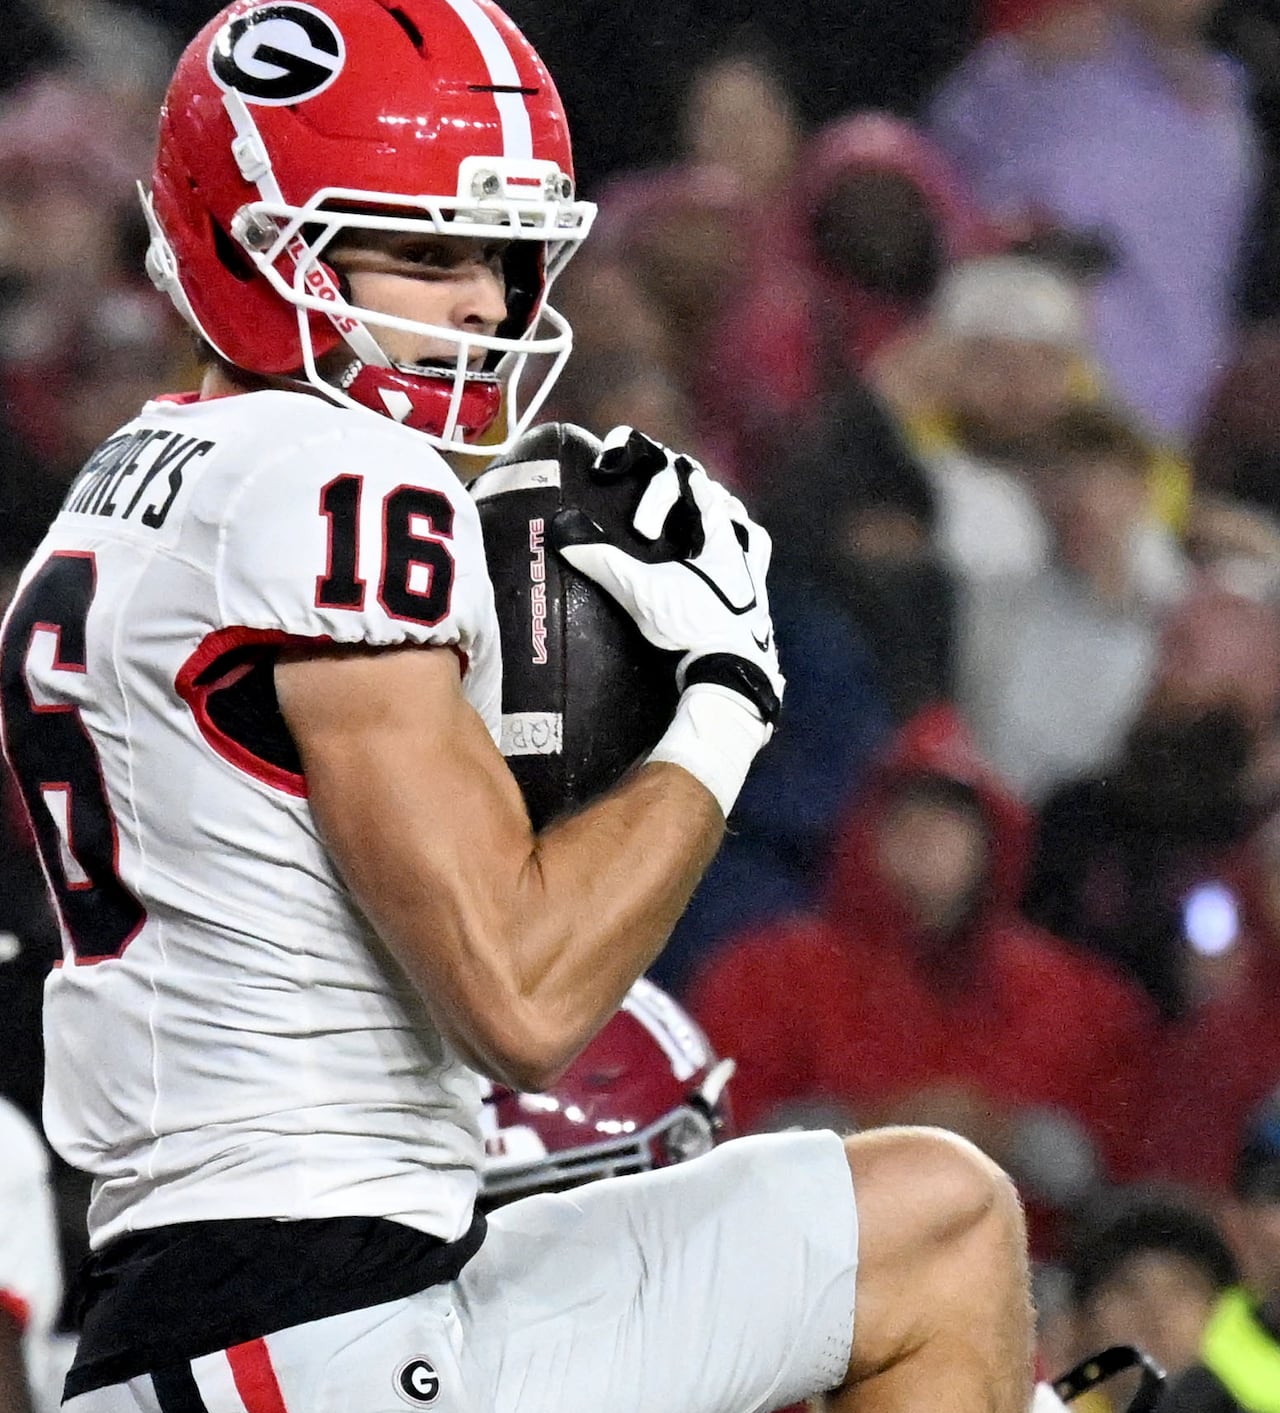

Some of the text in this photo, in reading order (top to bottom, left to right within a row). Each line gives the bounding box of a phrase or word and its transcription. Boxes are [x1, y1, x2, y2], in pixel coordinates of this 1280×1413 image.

[212, 5, 341, 99] G
[315, 473, 454, 626] 16
[528, 517, 548, 664] VAPOR ELITE
[400, 1360, 439, 1401] G
